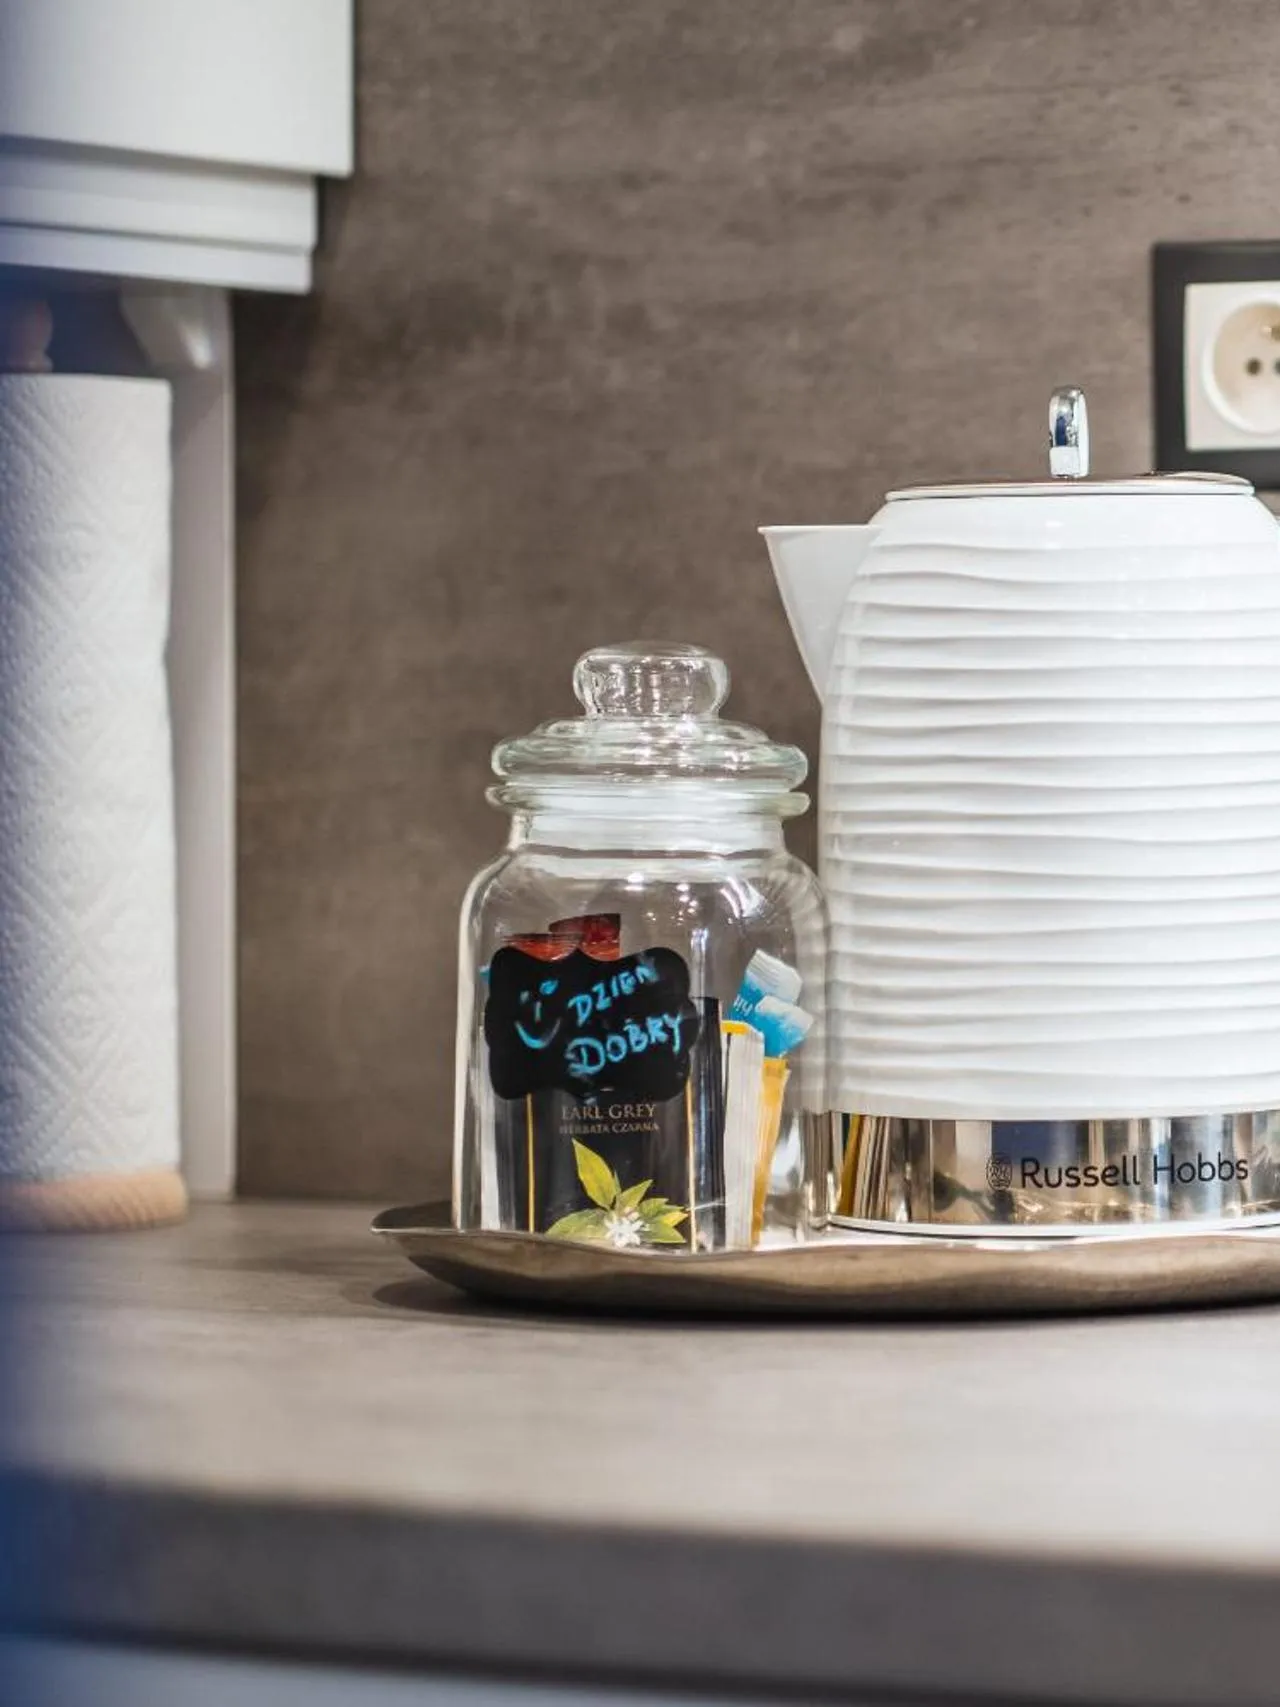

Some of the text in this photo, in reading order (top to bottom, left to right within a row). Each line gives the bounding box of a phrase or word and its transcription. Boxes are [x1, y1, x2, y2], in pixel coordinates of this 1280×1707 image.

[564, 1013, 682, 1077] DOBRY
[561, 1103, 657, 1121] EARL GREY
[1020, 1151, 1249, 1189] Russell Hobbs
